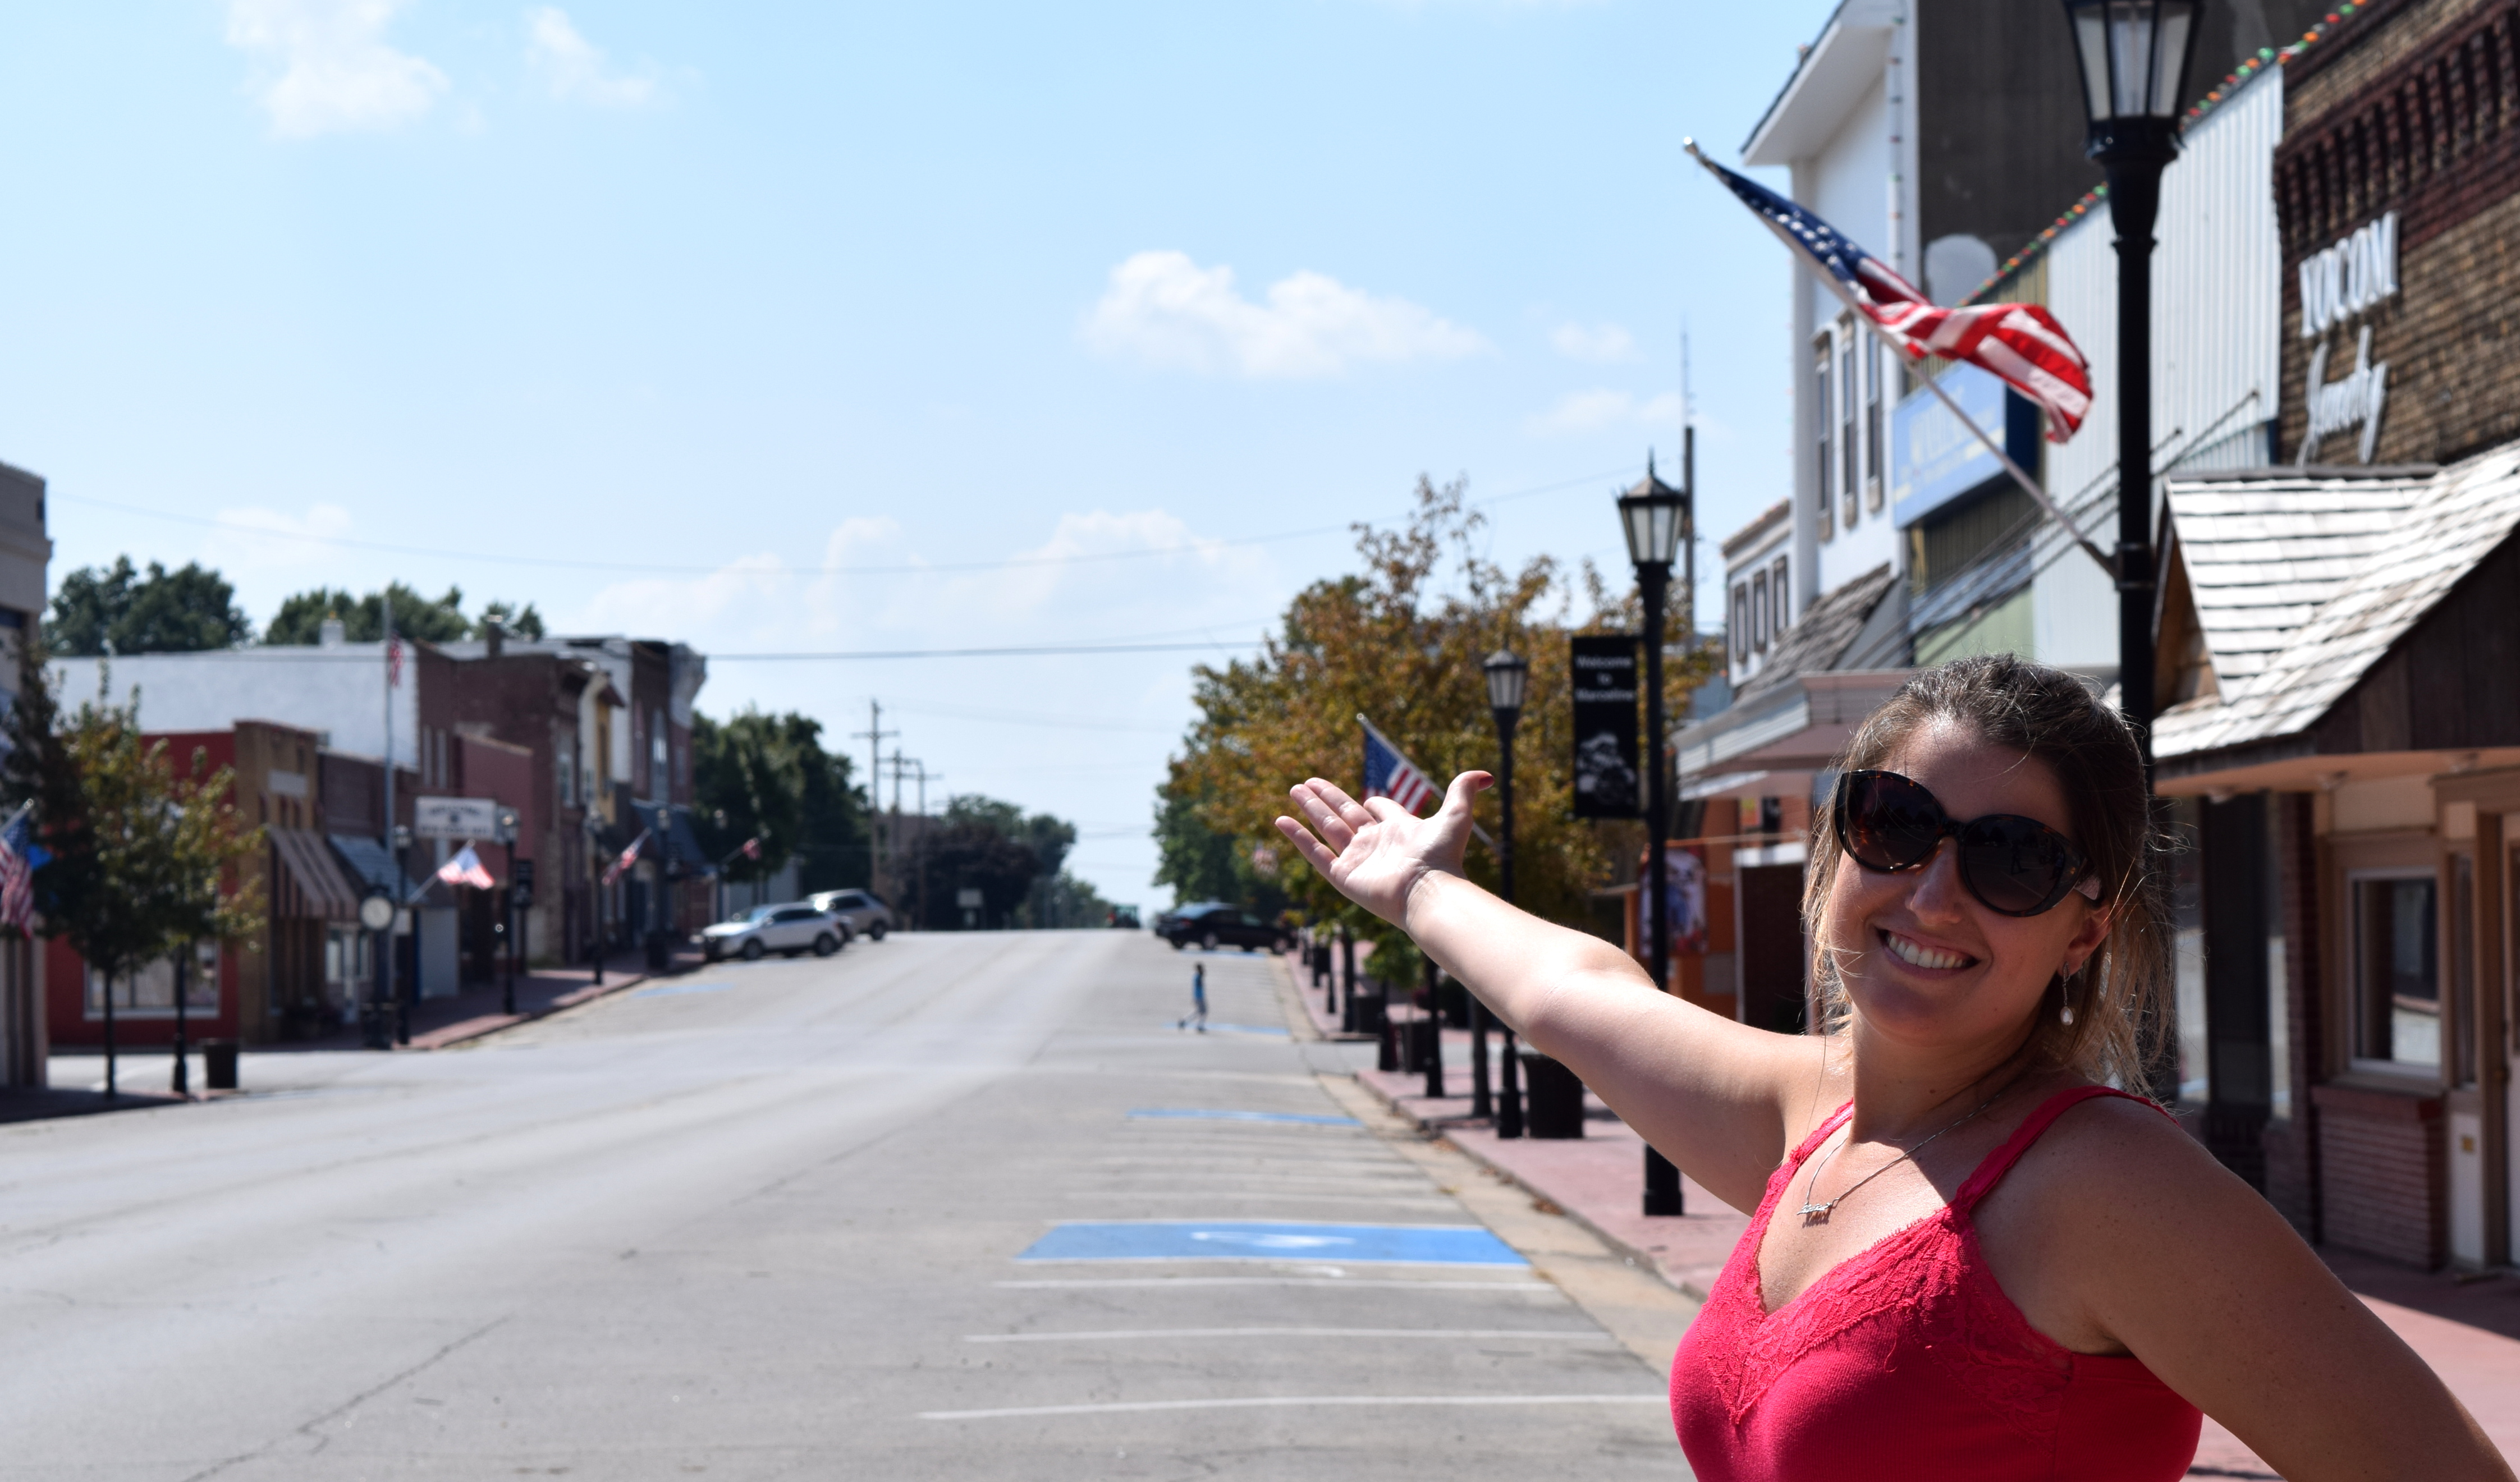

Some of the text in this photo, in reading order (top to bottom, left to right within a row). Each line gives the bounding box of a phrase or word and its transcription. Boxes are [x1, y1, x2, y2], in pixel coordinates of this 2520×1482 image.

[2299, 209, 2399, 337] YOCOM
[1575, 655, 1633, 668] Welcome
[1597, 673, 1612, 685] to
